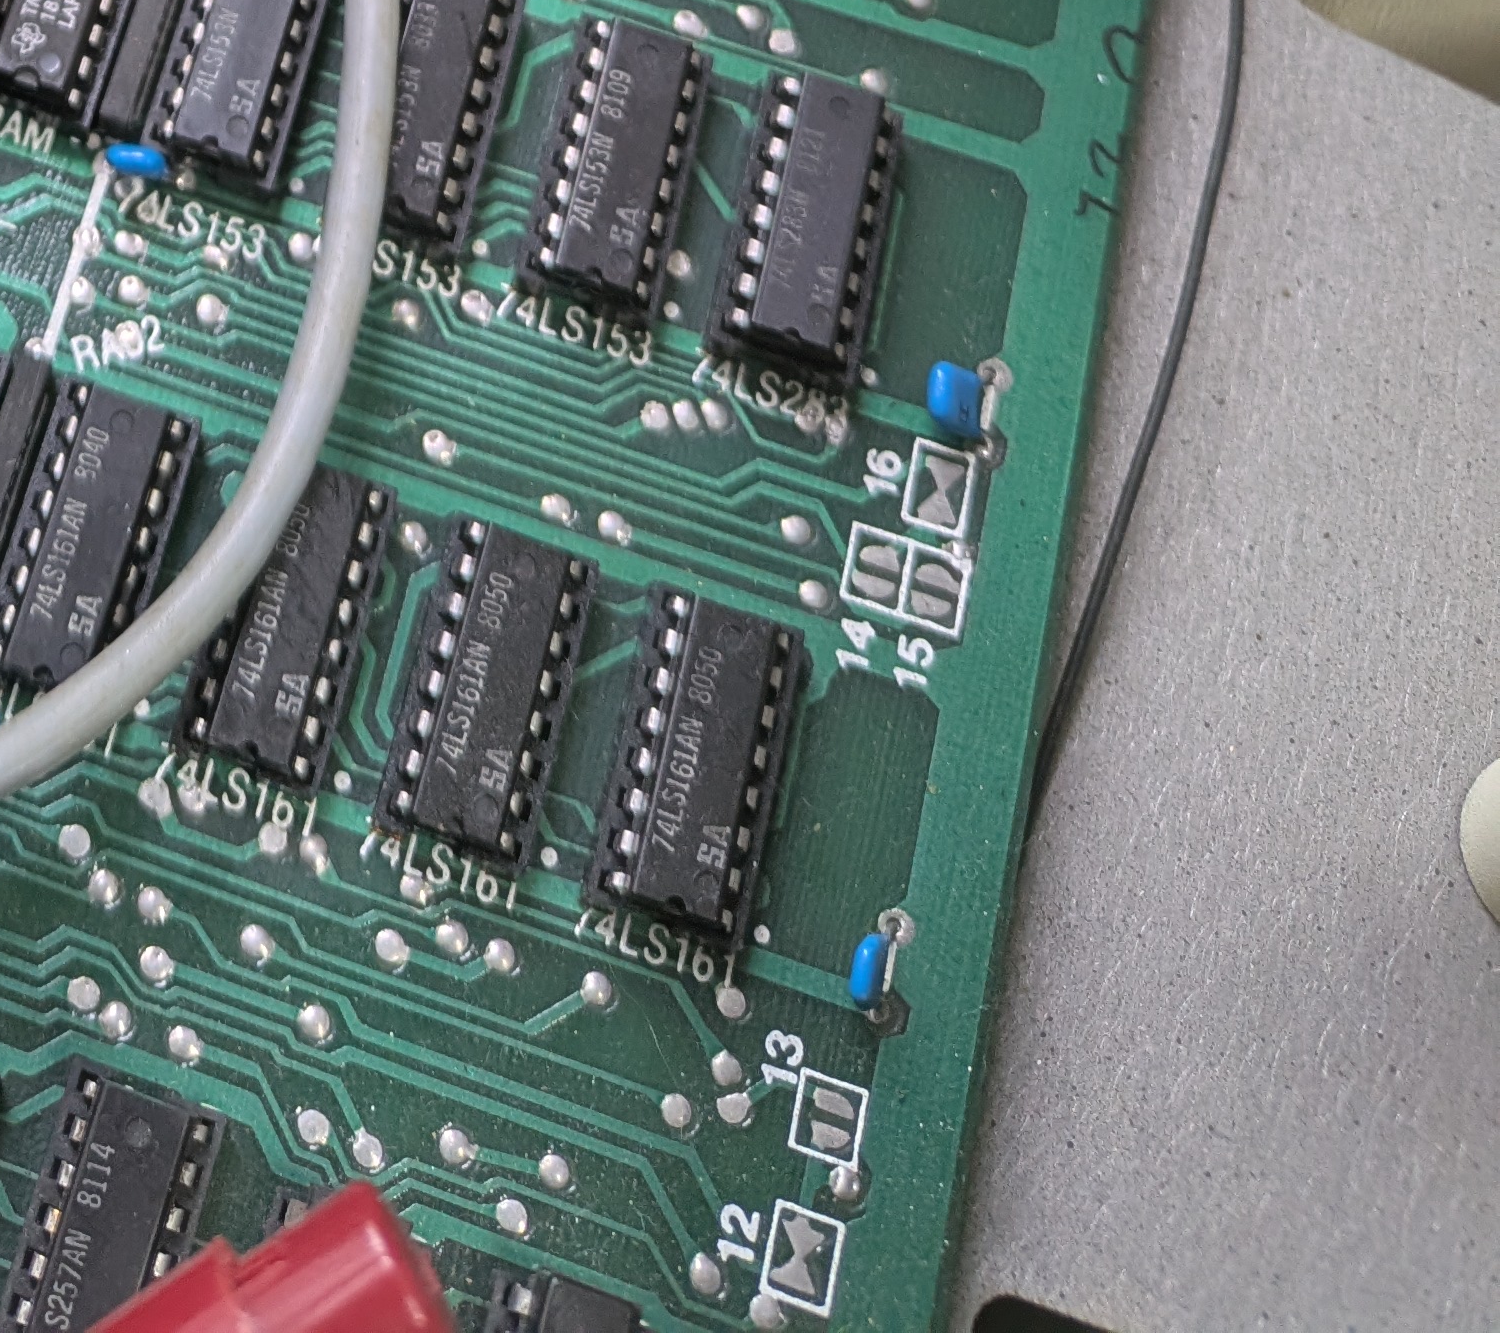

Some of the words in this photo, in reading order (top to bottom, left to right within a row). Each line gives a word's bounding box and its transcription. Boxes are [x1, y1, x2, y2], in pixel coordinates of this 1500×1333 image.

[191, 7, 240, 102] 74LS153N
[566, 132, 619, 232] 74LS153N
[598, 67, 635, 119] 8109
[491, 282, 656, 369] 74LS153
[857, 445, 908, 500] 16
[225, 567, 299, 699] 74LS161AN
[426, 638, 499, 774] 74LS161AN
[474, 571, 518, 630] 8050
[830, 615, 879, 674] 14
[886, 632, 937, 691] 15
[641, 714, 716, 852] 74LS161AN
[685, 643, 730, 706] 8050
[570, 898, 742, 990] 74LS161
[753, 1027, 810, 1091] 13
[69, 1139, 120, 1212] 8114
[706, 1201, 769, 1270] 12
